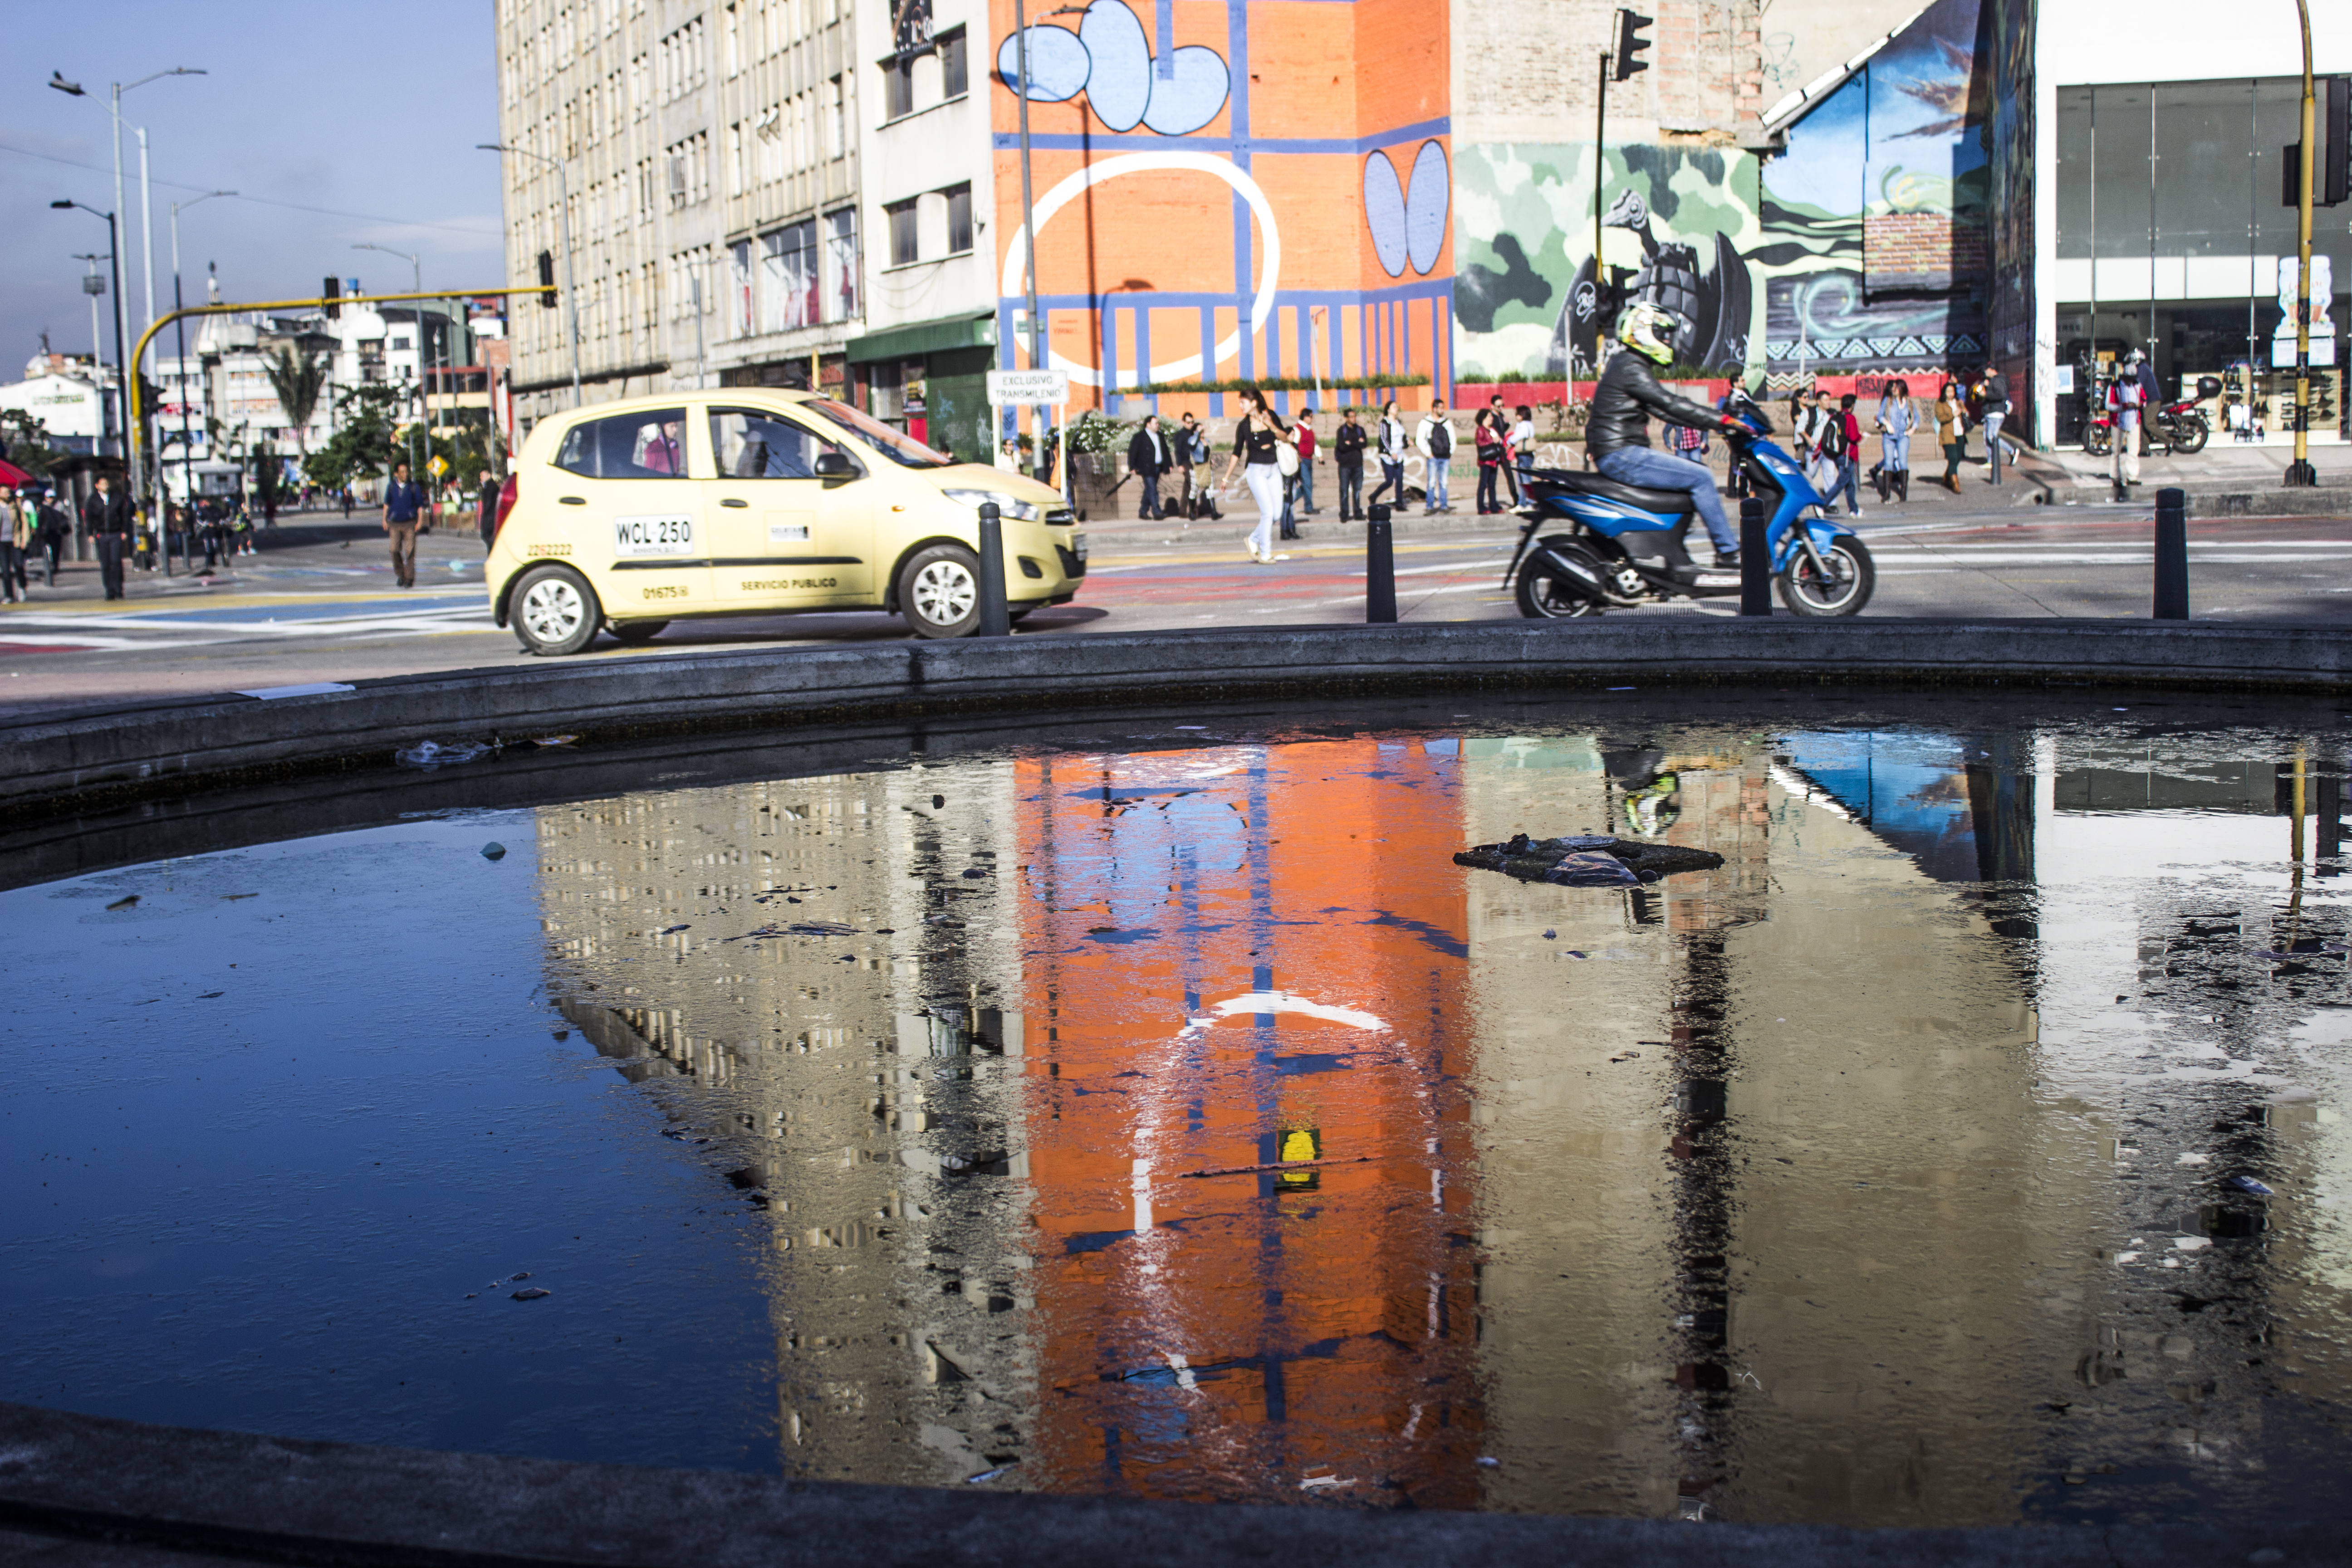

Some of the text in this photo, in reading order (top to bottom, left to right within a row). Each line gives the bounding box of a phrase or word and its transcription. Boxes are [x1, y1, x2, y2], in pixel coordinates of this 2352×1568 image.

[1002, 376, 1053, 386] EXCLUSIVO
[995, 389, 1061, 399] TRANSMILENIO
[741, 577, 837, 590] SERVICIO PUBLICO
